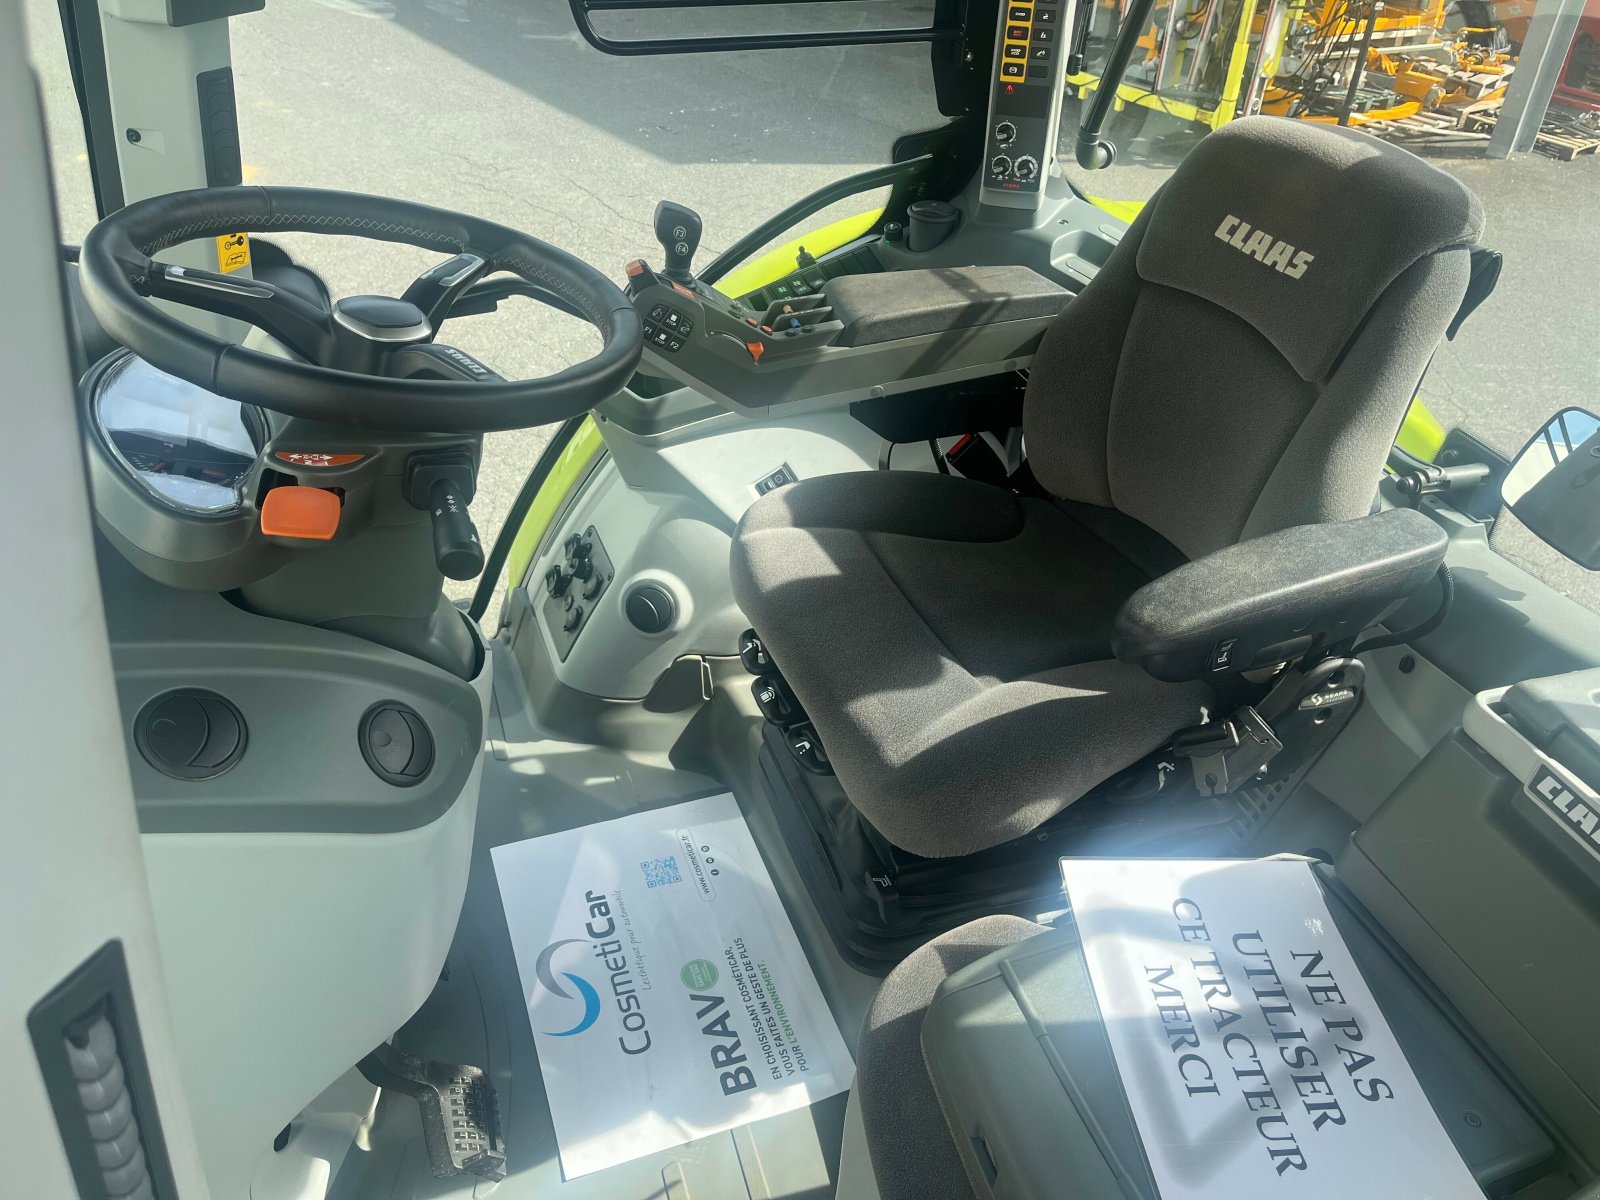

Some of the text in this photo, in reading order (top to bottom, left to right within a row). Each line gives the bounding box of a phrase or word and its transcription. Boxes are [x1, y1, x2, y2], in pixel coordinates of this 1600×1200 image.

[675, 229, 685, 238] F3
[677, 245, 687, 254] F4
[1214, 214, 1315, 279] CLAAS
[644, 326, 652, 334] F1
[655, 337, 665, 345] STOP
[666, 318, 677, 326] STOP
[670, 341, 679, 350] F2
[1537, 775, 1600, 845] CLA
[681, 835, 710, 895] www.cosmeticar.fr
[627, 928, 643, 944] pour
[734, 937, 795, 1076] VOUS FAITES UN GESTE DE PLUS
[746, 1005, 776, 1065] CHOISISSANT
[757, 960, 809, 1072] POUR L'ENVIRONNEMENT.
[1144, 964, 1221, 1098] MERCI
[1232, 929, 1347, 1132] UTILISER
[1290, 950, 1395, 1102] NE PAS
[1172, 897, 1308, 1177] CE TRACTEUR
[770, 1065, 782, 1080] EN
